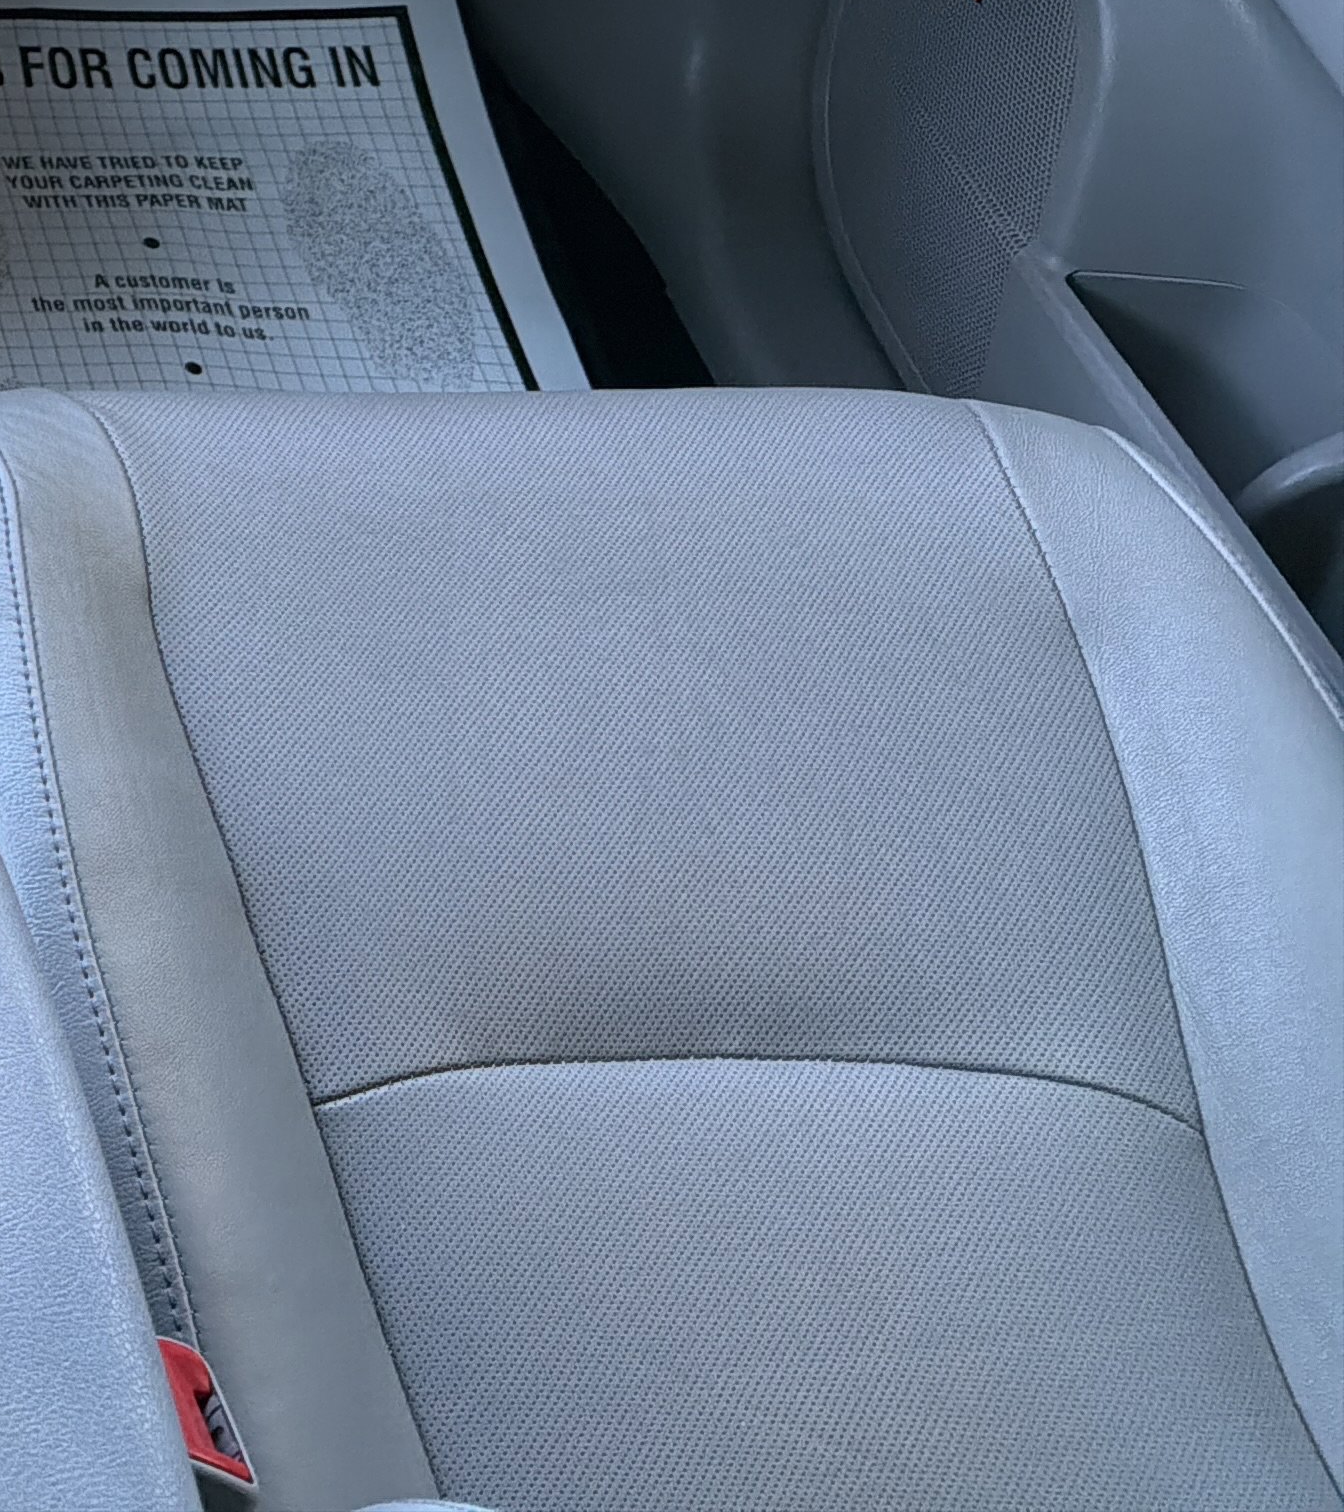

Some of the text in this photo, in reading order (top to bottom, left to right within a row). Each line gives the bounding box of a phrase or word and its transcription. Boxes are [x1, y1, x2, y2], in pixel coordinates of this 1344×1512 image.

[19, 45, 114, 90] FOR
[127, 45, 315, 90] COMING
[327, 45, 382, 88] IN
[1, 154, 243, 171] WE HAVE TRIED TO KEEP
[5, 174, 254, 191] YOUR CARPETING CLEAN
[23, 194, 248, 212] WITH THIS PAPER MAT
[95, 274, 236, 294] A customer is
[32, 296, 310, 321] the most important person
[84, 318, 274, 342] in the world to us.
